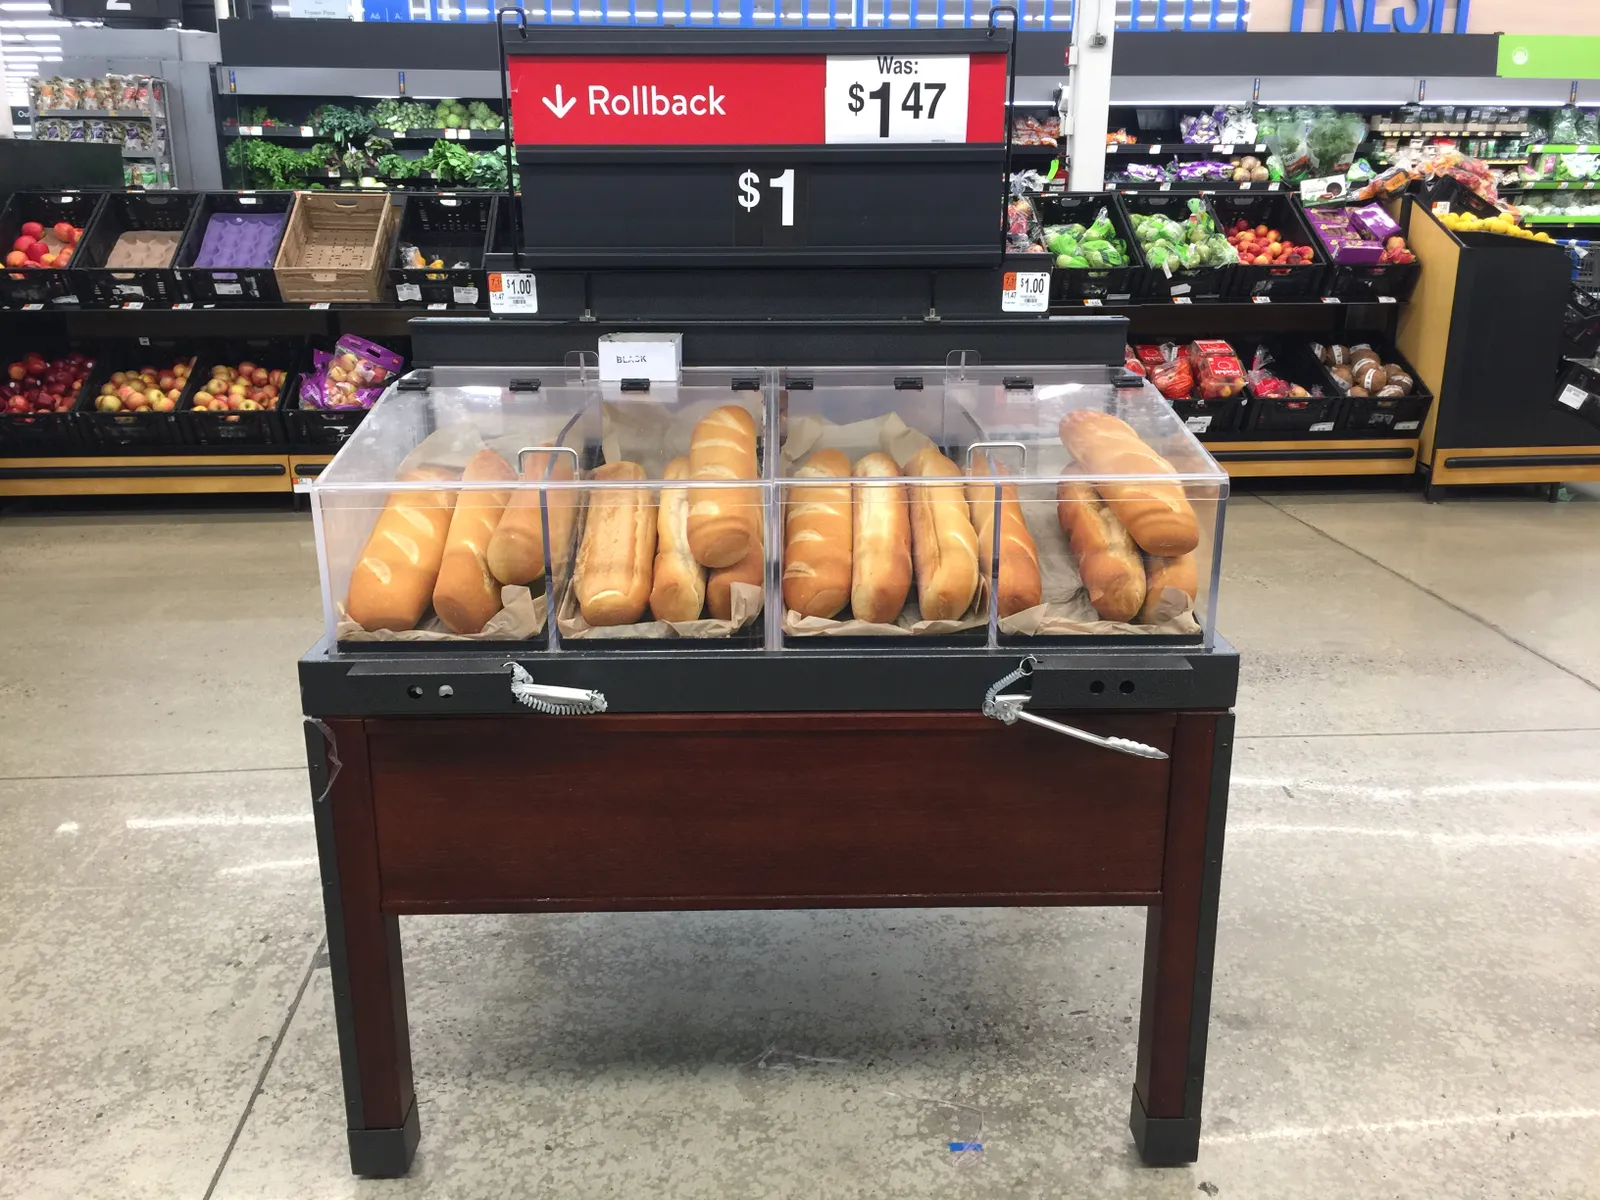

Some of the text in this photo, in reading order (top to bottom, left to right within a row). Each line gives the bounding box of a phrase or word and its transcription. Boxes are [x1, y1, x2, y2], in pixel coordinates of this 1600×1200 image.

[876, 55, 919, 75] Was:
[587, 84, 727, 116] Rollback
[737, 168, 795, 227] $1
[506, 279, 531, 295] $1.00
[1020, 277, 1045, 293] $1.00
[616, 355, 647, 364] BLACK
